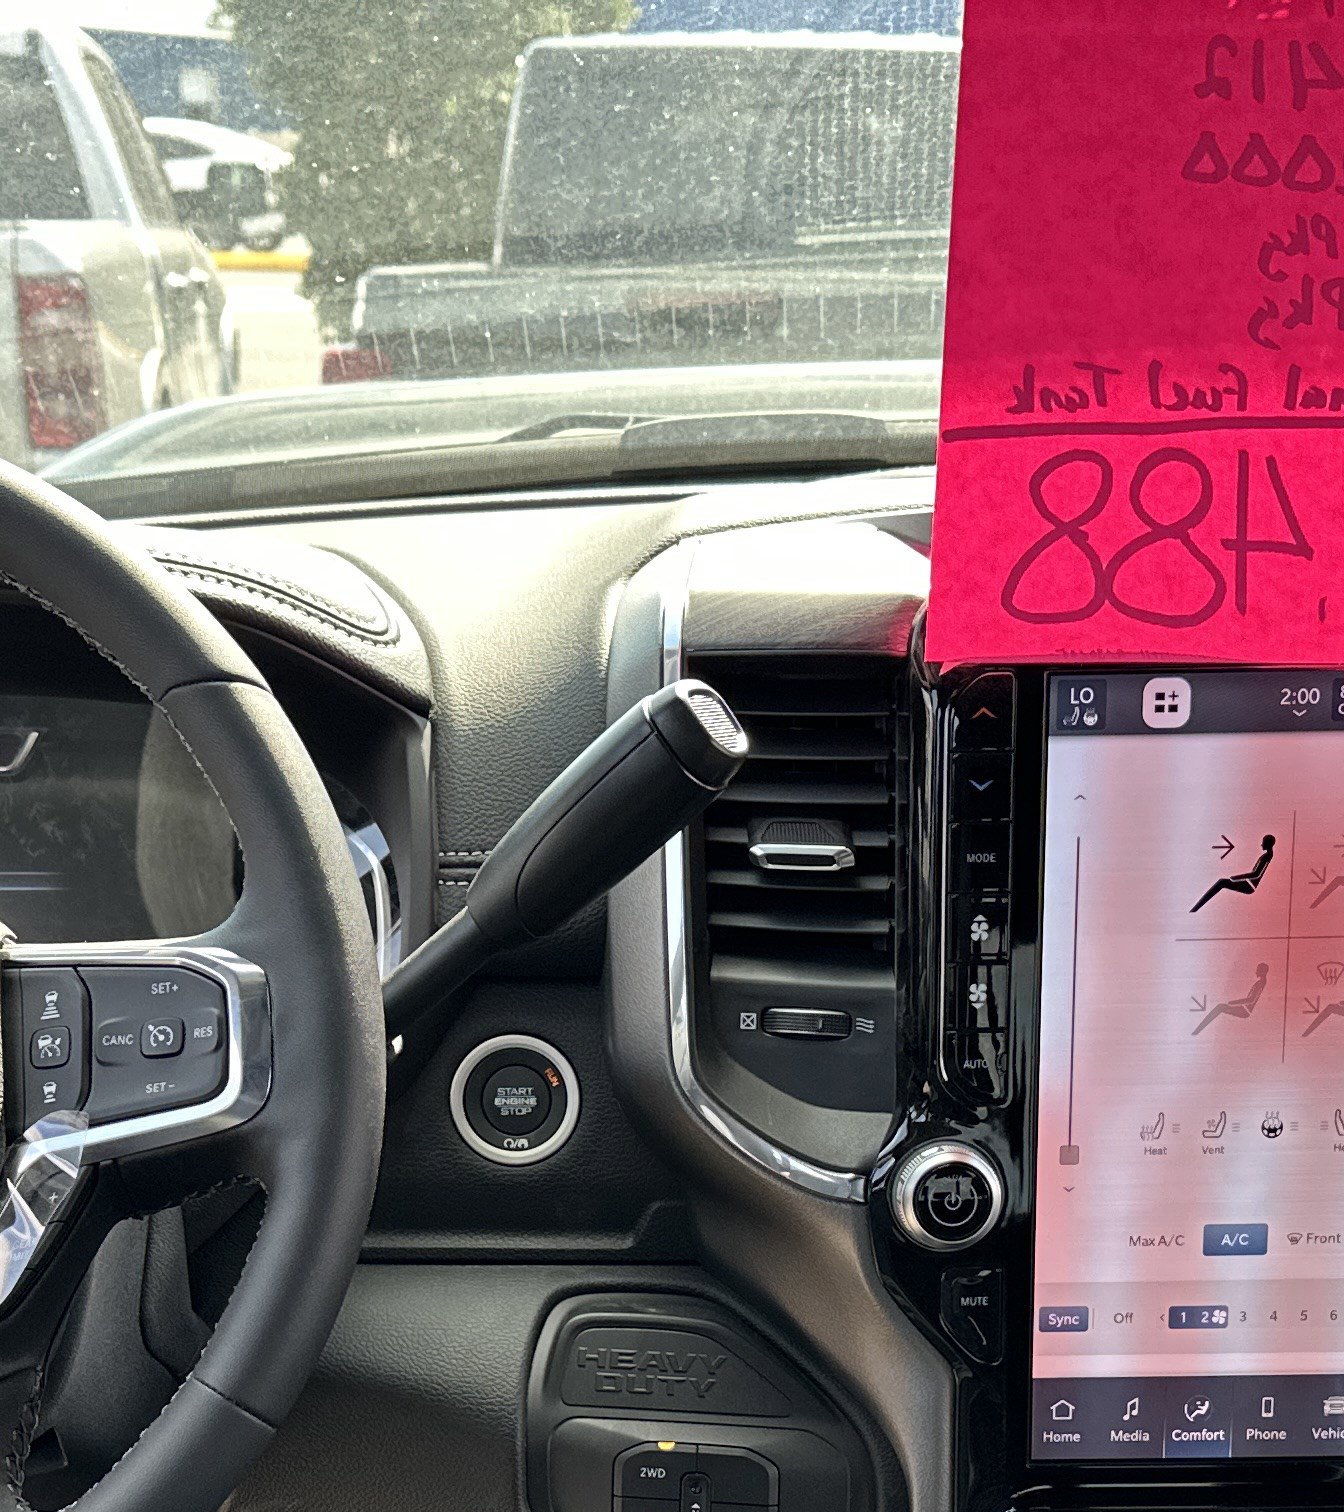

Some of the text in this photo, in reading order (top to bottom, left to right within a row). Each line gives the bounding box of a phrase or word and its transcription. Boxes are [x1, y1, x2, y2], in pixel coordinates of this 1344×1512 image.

[1070, 687, 1094, 705] LO
[1280, 688, 1320, 706] 2:00
[966, 853, 997, 863] MODE
[193, 1025, 213, 1038] RES
[102, 1034, 134, 1046] CANC
[497, 1087, 533, 1096] START
[494, 1097, 537, 1106] ENGINE
[500, 1107, 532, 1116] STOP
[1144, 1145, 1168, 1155] Heat
[1201, 1144, 1225, 1155] Vent
[1128, 1235, 1185, 1247] Max A/C
[1220, 1233, 1250, 1247] A/C
[1306, 1232, 1342, 1244] Front
[960, 1296, 989, 1306] MUTE
[1047, 1313, 1080, 1331] Sync
[1113, 1312, 1134, 1325] Off
[1179, 1312, 1187, 1324] 1
[1200, 1311, 1209, 1324] 2
[1239, 1310, 1247, 1322] 3
[1269, 1310, 1278, 1322] 4
[1299, 1309, 1308, 1321] 5
[1329, 1309, 1338, 1321] 6
[578, 1346, 728, 1375] HEAVY
[595, 1371, 716, 1398] DUTY
[1043, 1430, 1081, 1443] Home
[1110, 1429, 1150, 1442] Media
[1171, 1429, 1225, 1441] Comfort
[1246, 1428, 1287, 1440] Phone
[639, 1467, 666, 1478] 2WD
